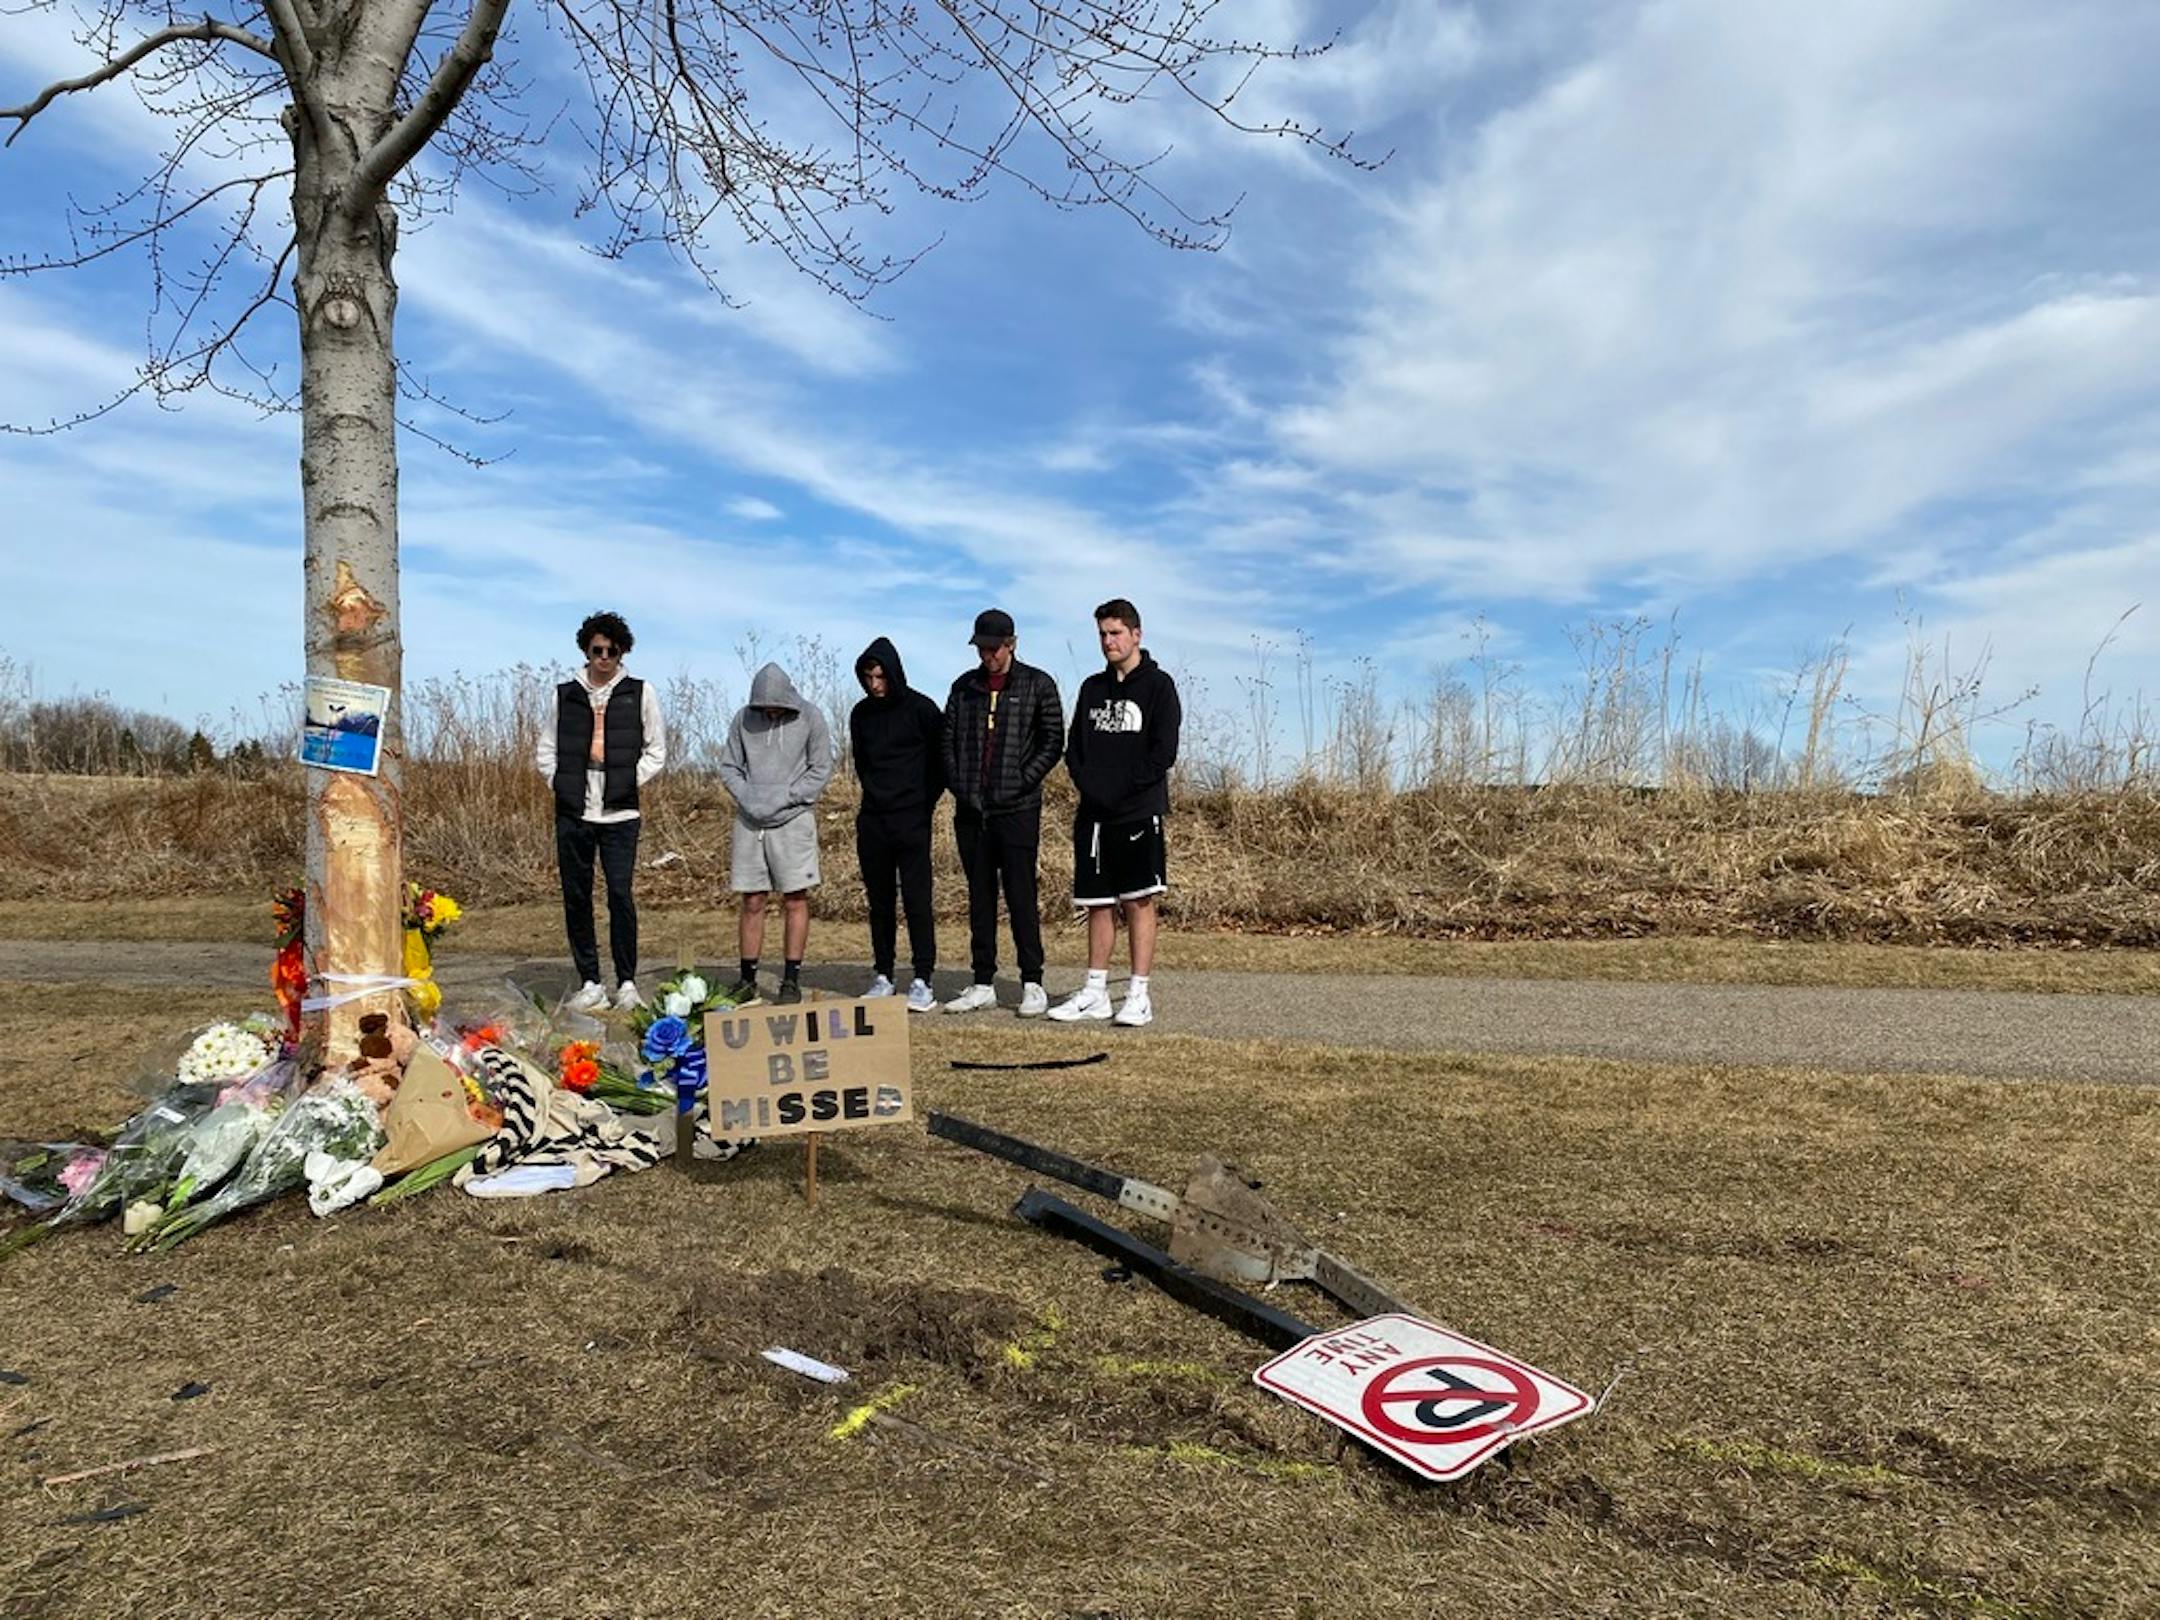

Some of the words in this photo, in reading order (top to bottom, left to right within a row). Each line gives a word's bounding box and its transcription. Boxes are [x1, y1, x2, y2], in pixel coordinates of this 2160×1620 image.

[722, 1018, 749, 1049] U
[766, 1006, 874, 1046] WILL
[767, 1050, 829, 1085] BE
[721, 1086, 903, 1131] MISSED
[1304, 1332, 1383, 1366] TIME
[1340, 1343, 1402, 1376] ANY
